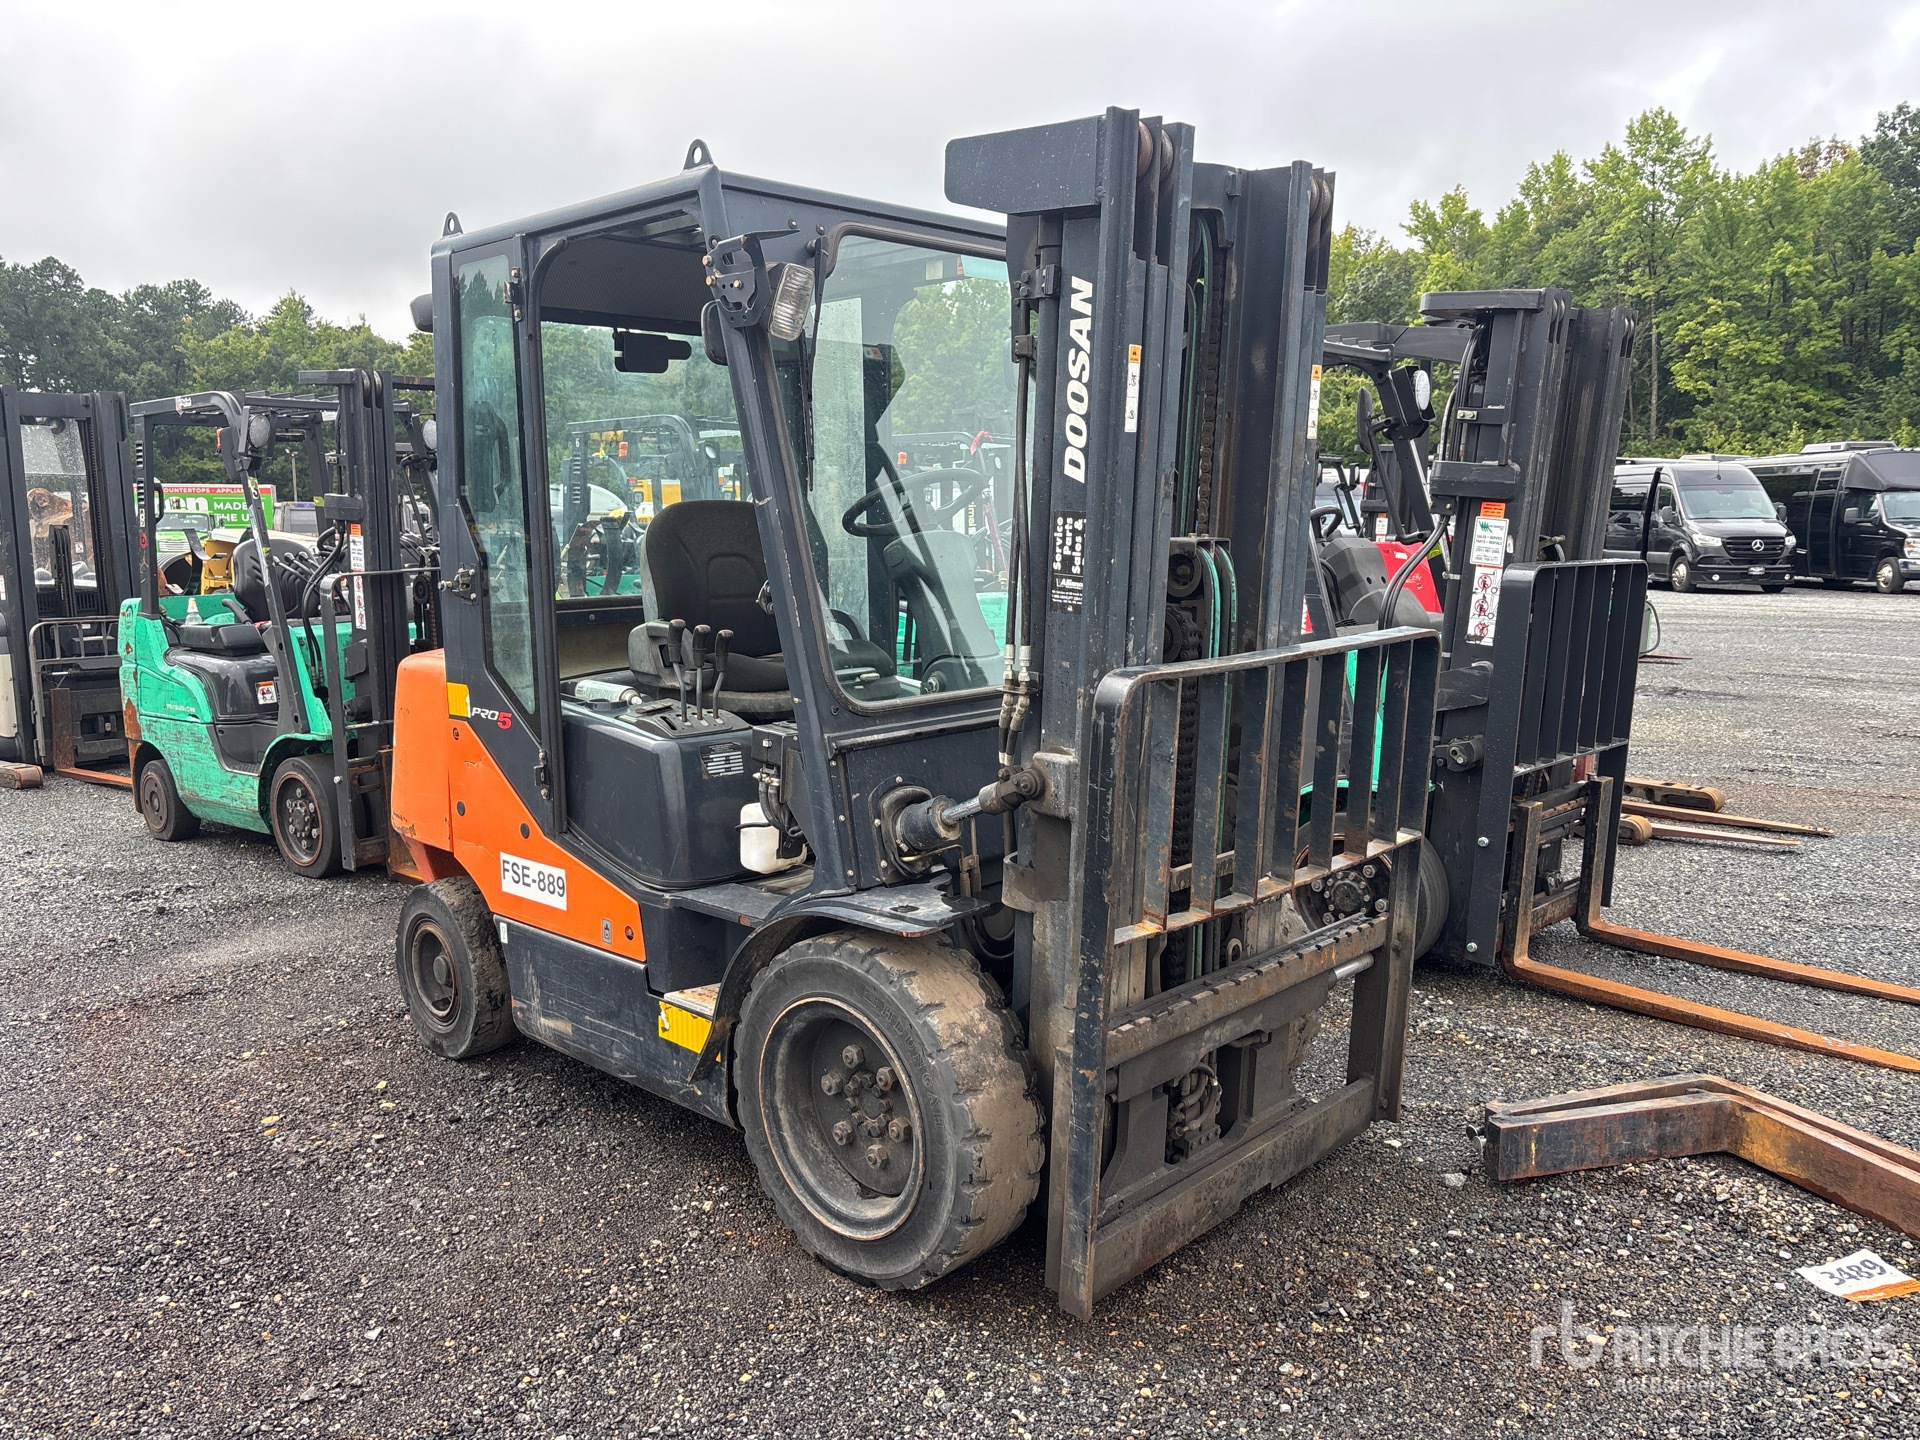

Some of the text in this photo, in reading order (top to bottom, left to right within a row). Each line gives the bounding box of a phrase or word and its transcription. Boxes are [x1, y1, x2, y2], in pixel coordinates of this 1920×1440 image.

[1064, 275, 1093, 484] DOOSAN
[1053, 516, 1064, 571] Service
[1062, 517, 1073, 556] Parts
[1071, 518, 1083, 575] Sales &
[502, 859, 566, 898] FSE-889
[1820, 1258, 1887, 1287] 3489
